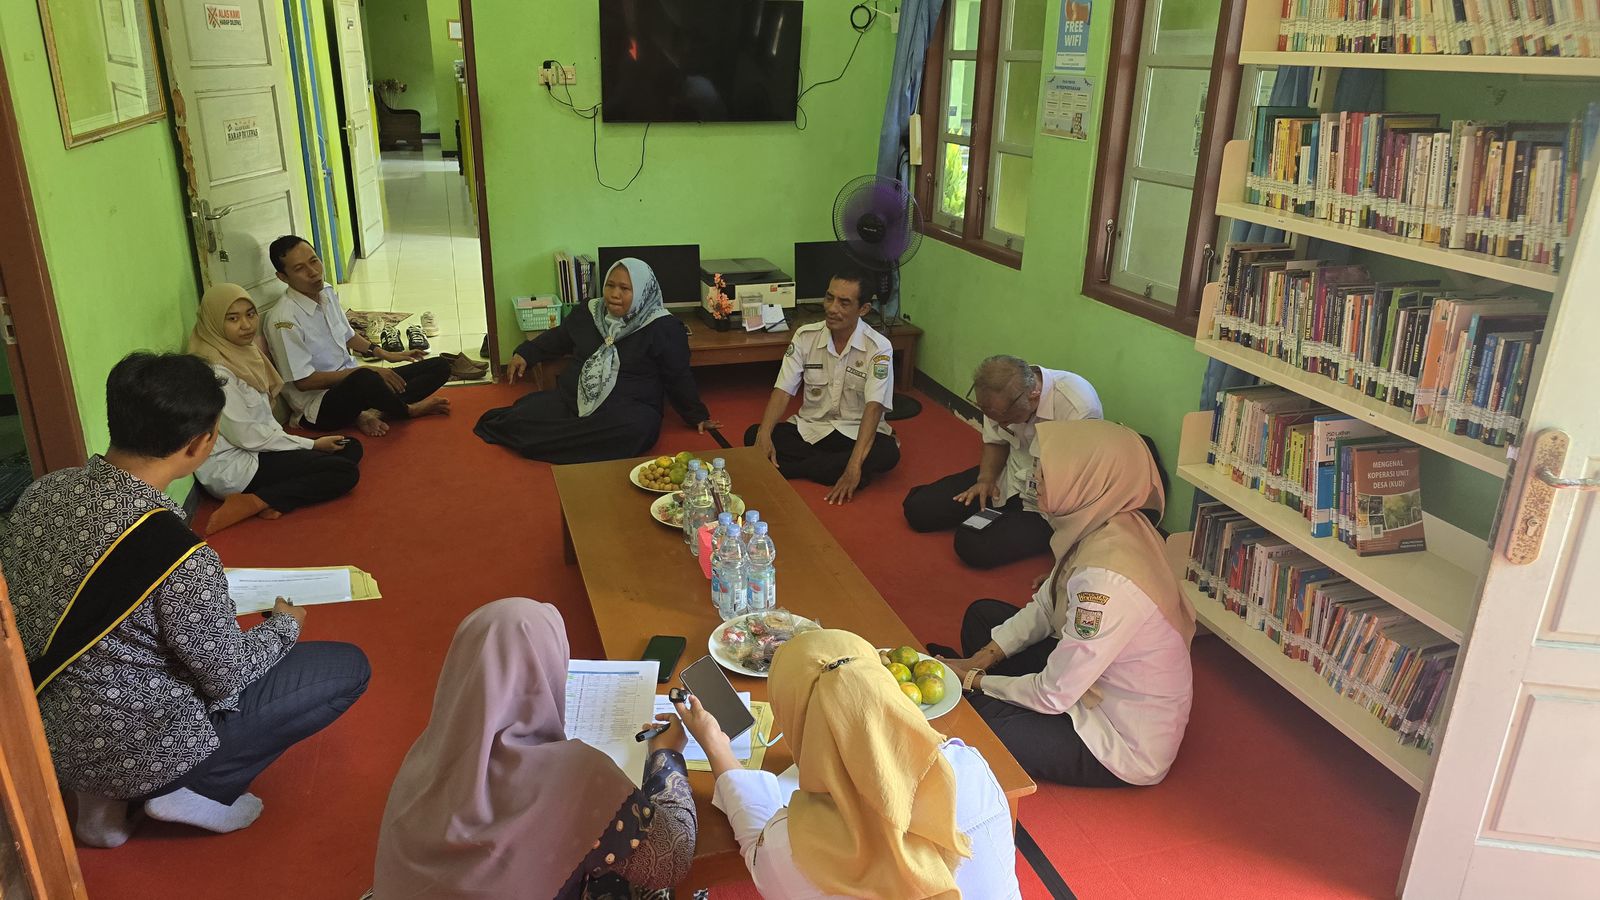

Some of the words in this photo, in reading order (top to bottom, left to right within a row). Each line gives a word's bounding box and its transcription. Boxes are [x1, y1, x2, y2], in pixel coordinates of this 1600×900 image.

[218, 9, 229, 18] ALAS
[1064, 21, 1084, 33] FREE
[1064, 34, 1082, 47] WIFI
[1372, 460, 1404, 469] MENGENAL
[1367, 470, 1396, 479] KOPERASI
[1372, 481, 1388, 489] DESA
[1388, 480, 1406, 488] (KUD)
